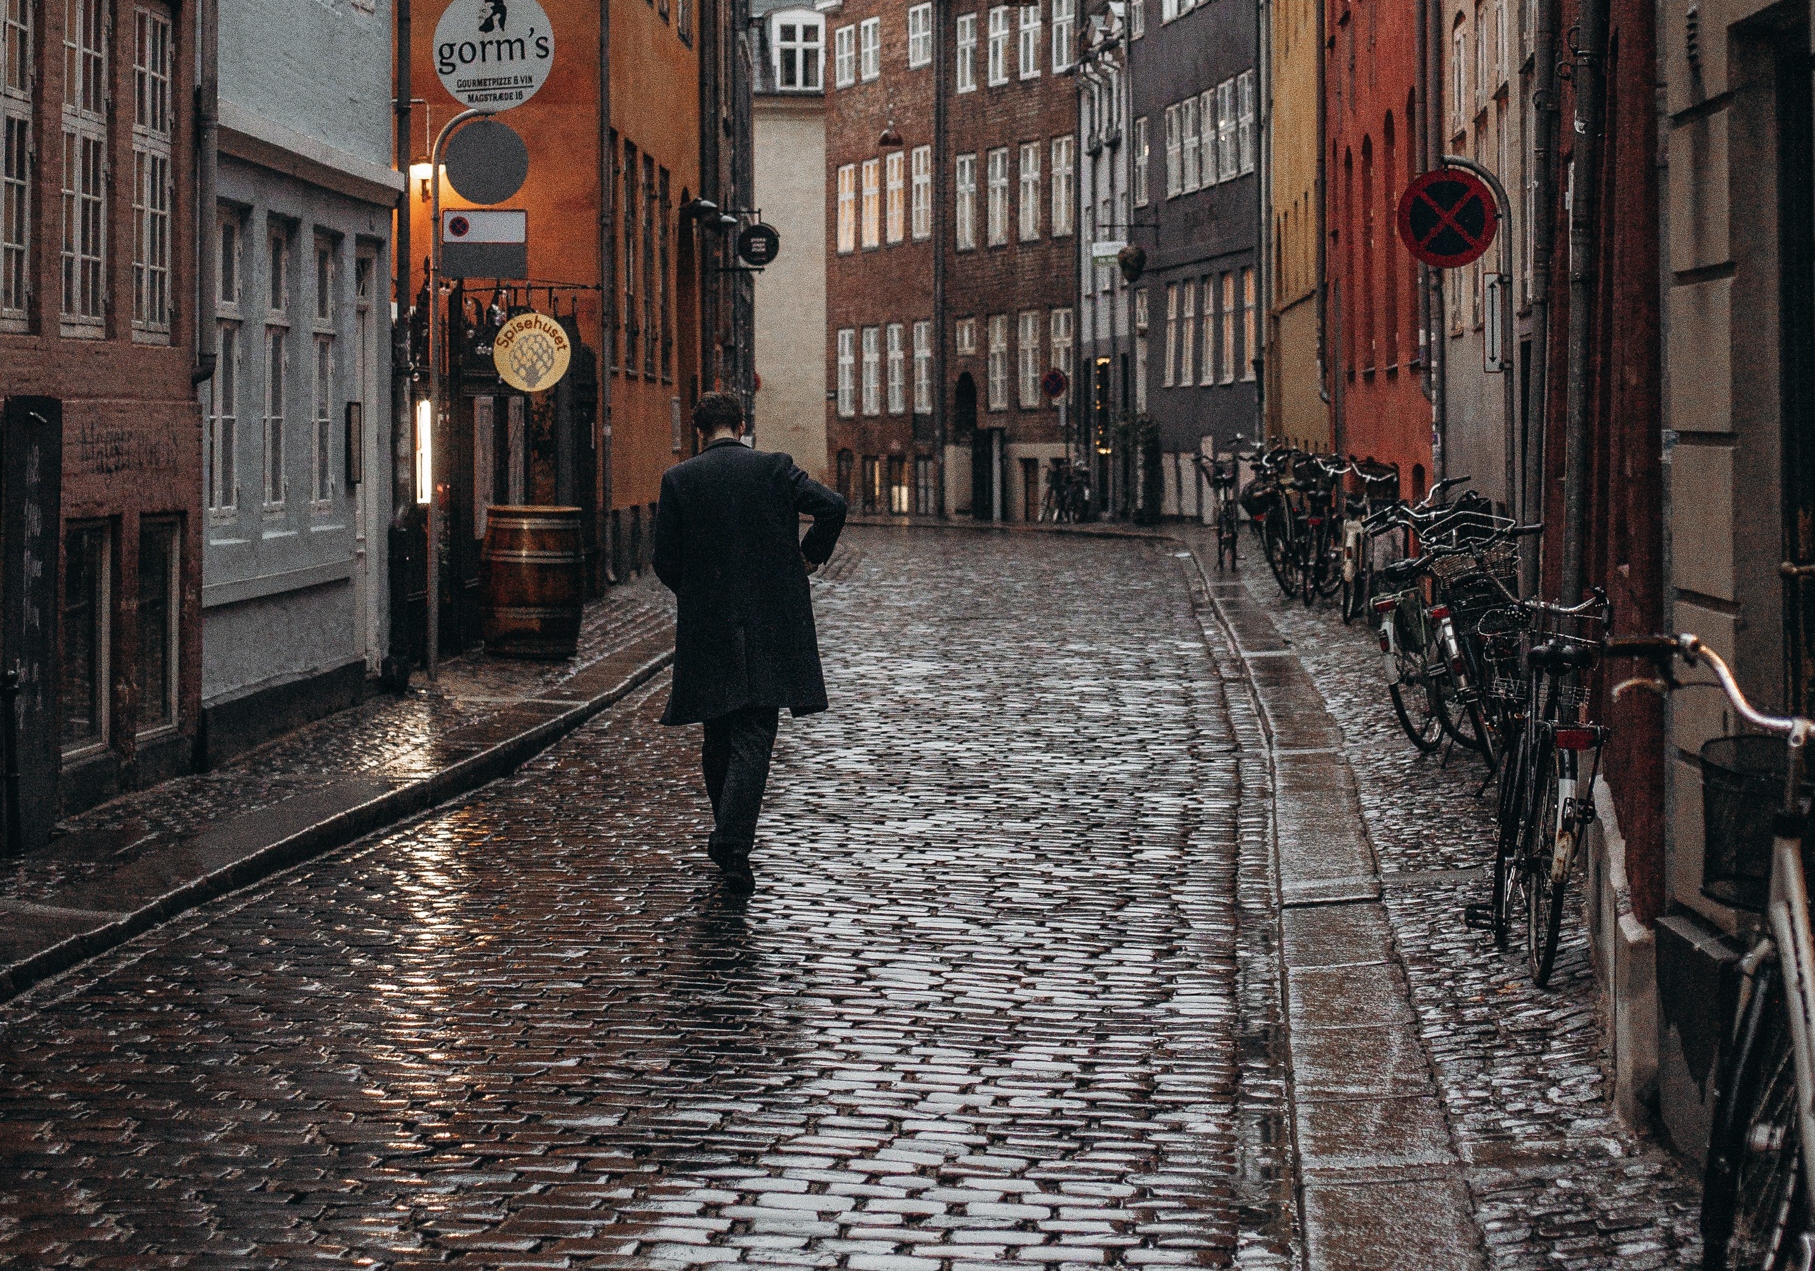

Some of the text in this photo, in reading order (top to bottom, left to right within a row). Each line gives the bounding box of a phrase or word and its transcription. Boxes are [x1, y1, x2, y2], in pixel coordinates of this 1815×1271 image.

[438, 27, 550, 75] gorm's
[457, 77, 512, 88] GOURMETPIZZE
[520, 75, 533, 84] VIN
[468, 92, 514, 102] MAGSTRÆDE
[496, 315, 568, 351] Spisehuset
